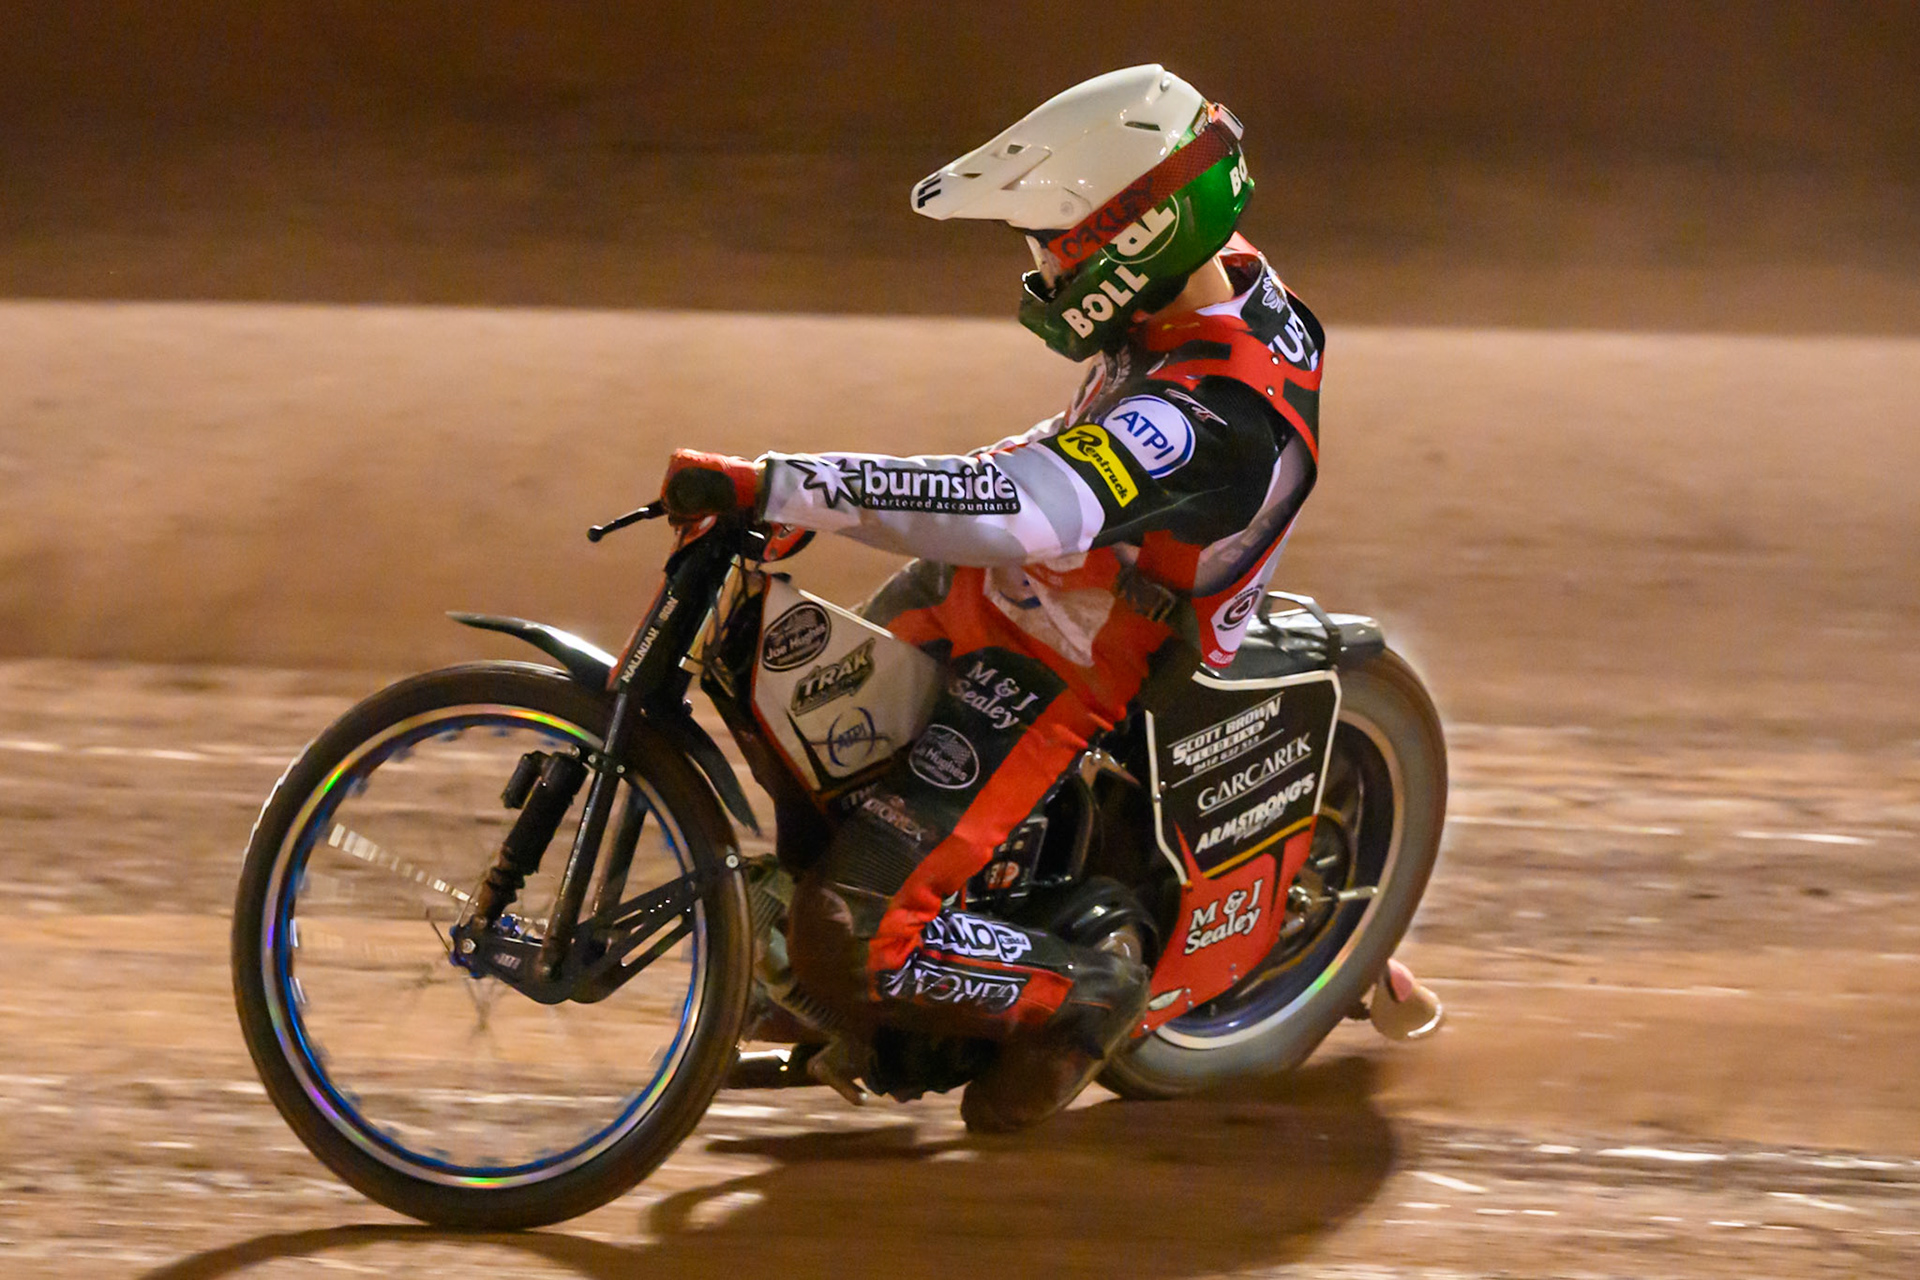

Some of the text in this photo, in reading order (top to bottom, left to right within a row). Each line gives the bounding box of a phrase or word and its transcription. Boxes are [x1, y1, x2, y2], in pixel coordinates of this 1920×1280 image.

[1061, 175, 1154, 260] OAKLEY
[1061, 264, 1150, 339] BOLL
[1112, 410, 1175, 461] ATPI
[864, 462, 1017, 500] burnside
[1063, 429, 1129, 502] Rentruck
[865, 497, 1019, 512] chartered accountants
[949, 678, 1019, 730] Sealey
[966, 660, 1039, 712] M & J
[1172, 727, 1223, 766] SCOTT
[1225, 697, 1281, 734] BROWN
[925, 748, 968, 783] Hughes
[1197, 732, 1312, 811] GARCAREK
[1184, 906, 1262, 955] Sealey
[1189, 878, 1264, 932] M & J
